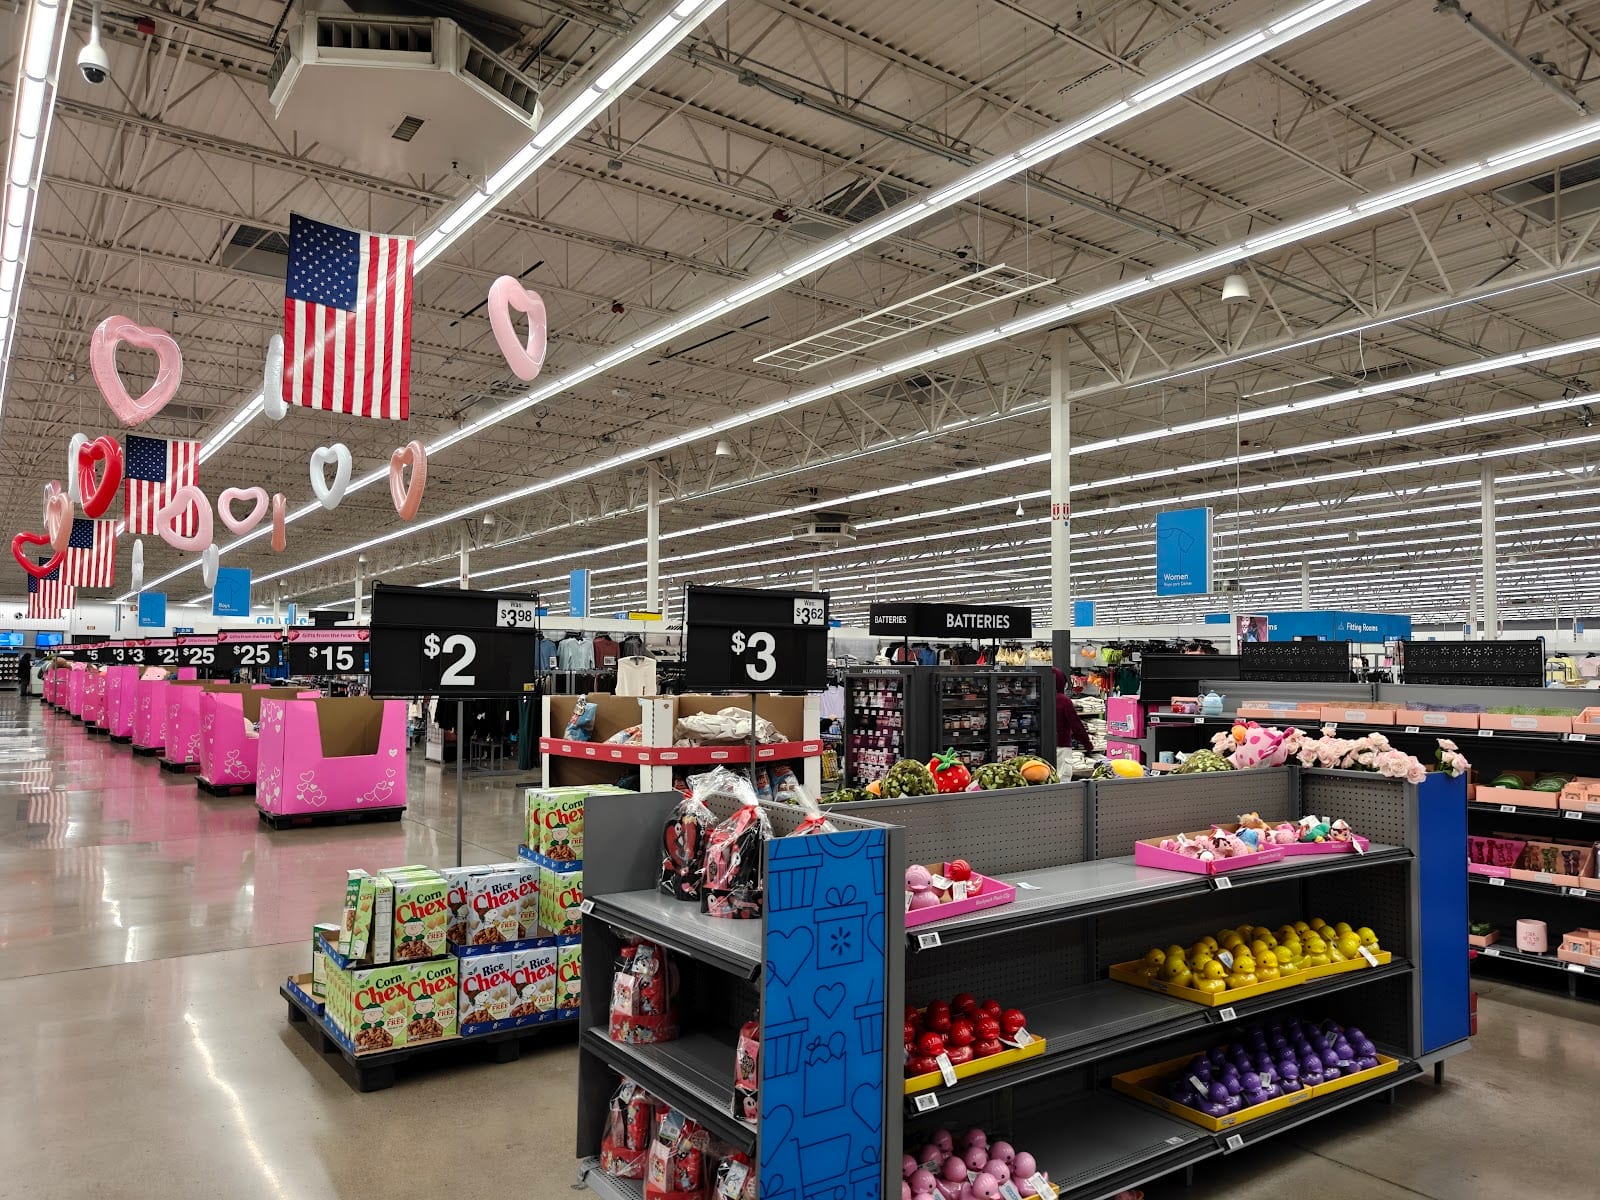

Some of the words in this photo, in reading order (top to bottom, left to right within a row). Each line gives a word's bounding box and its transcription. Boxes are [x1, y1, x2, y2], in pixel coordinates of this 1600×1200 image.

[1163, 573, 1188, 581] Women
[874, 615, 907, 624] BATTERIES
[946, 613, 1010, 629] BATTERIES
[1346, 622, 1361, 633] Fitting
[1363, 623, 1378, 632] Rooms
[182, 647, 215, 665] $25
[233, 644, 270, 664] $25
[309, 646, 354, 671] $15
[424, 632, 477, 686] $2
[731, 630, 777, 682] $3
[562, 800, 583, 812] Corn
[520, 874, 532, 884] ice
[492, 882, 512, 894] Rice
[519, 880, 540, 896] ex
[417, 891, 442, 904] Corn
[473, 888, 520, 912] Chex
[396, 897, 447, 924] Chex
[427, 932, 444, 940] FREE
[482, 963, 504, 976] Rice
[530, 957, 550, 970] Rice
[426, 966, 452, 981] Corn
[463, 968, 512, 994] Chex
[511, 962, 557, 986] Chex
[376, 974, 402, 989] Corn
[407, 974, 458, 1002] Chex
[354, 981, 408, 1011] Chex
[437, 1009, 455, 1017] FREE
[492, 1003, 507, 1011] FREE
[386, 1018, 405, 1026] FREE
